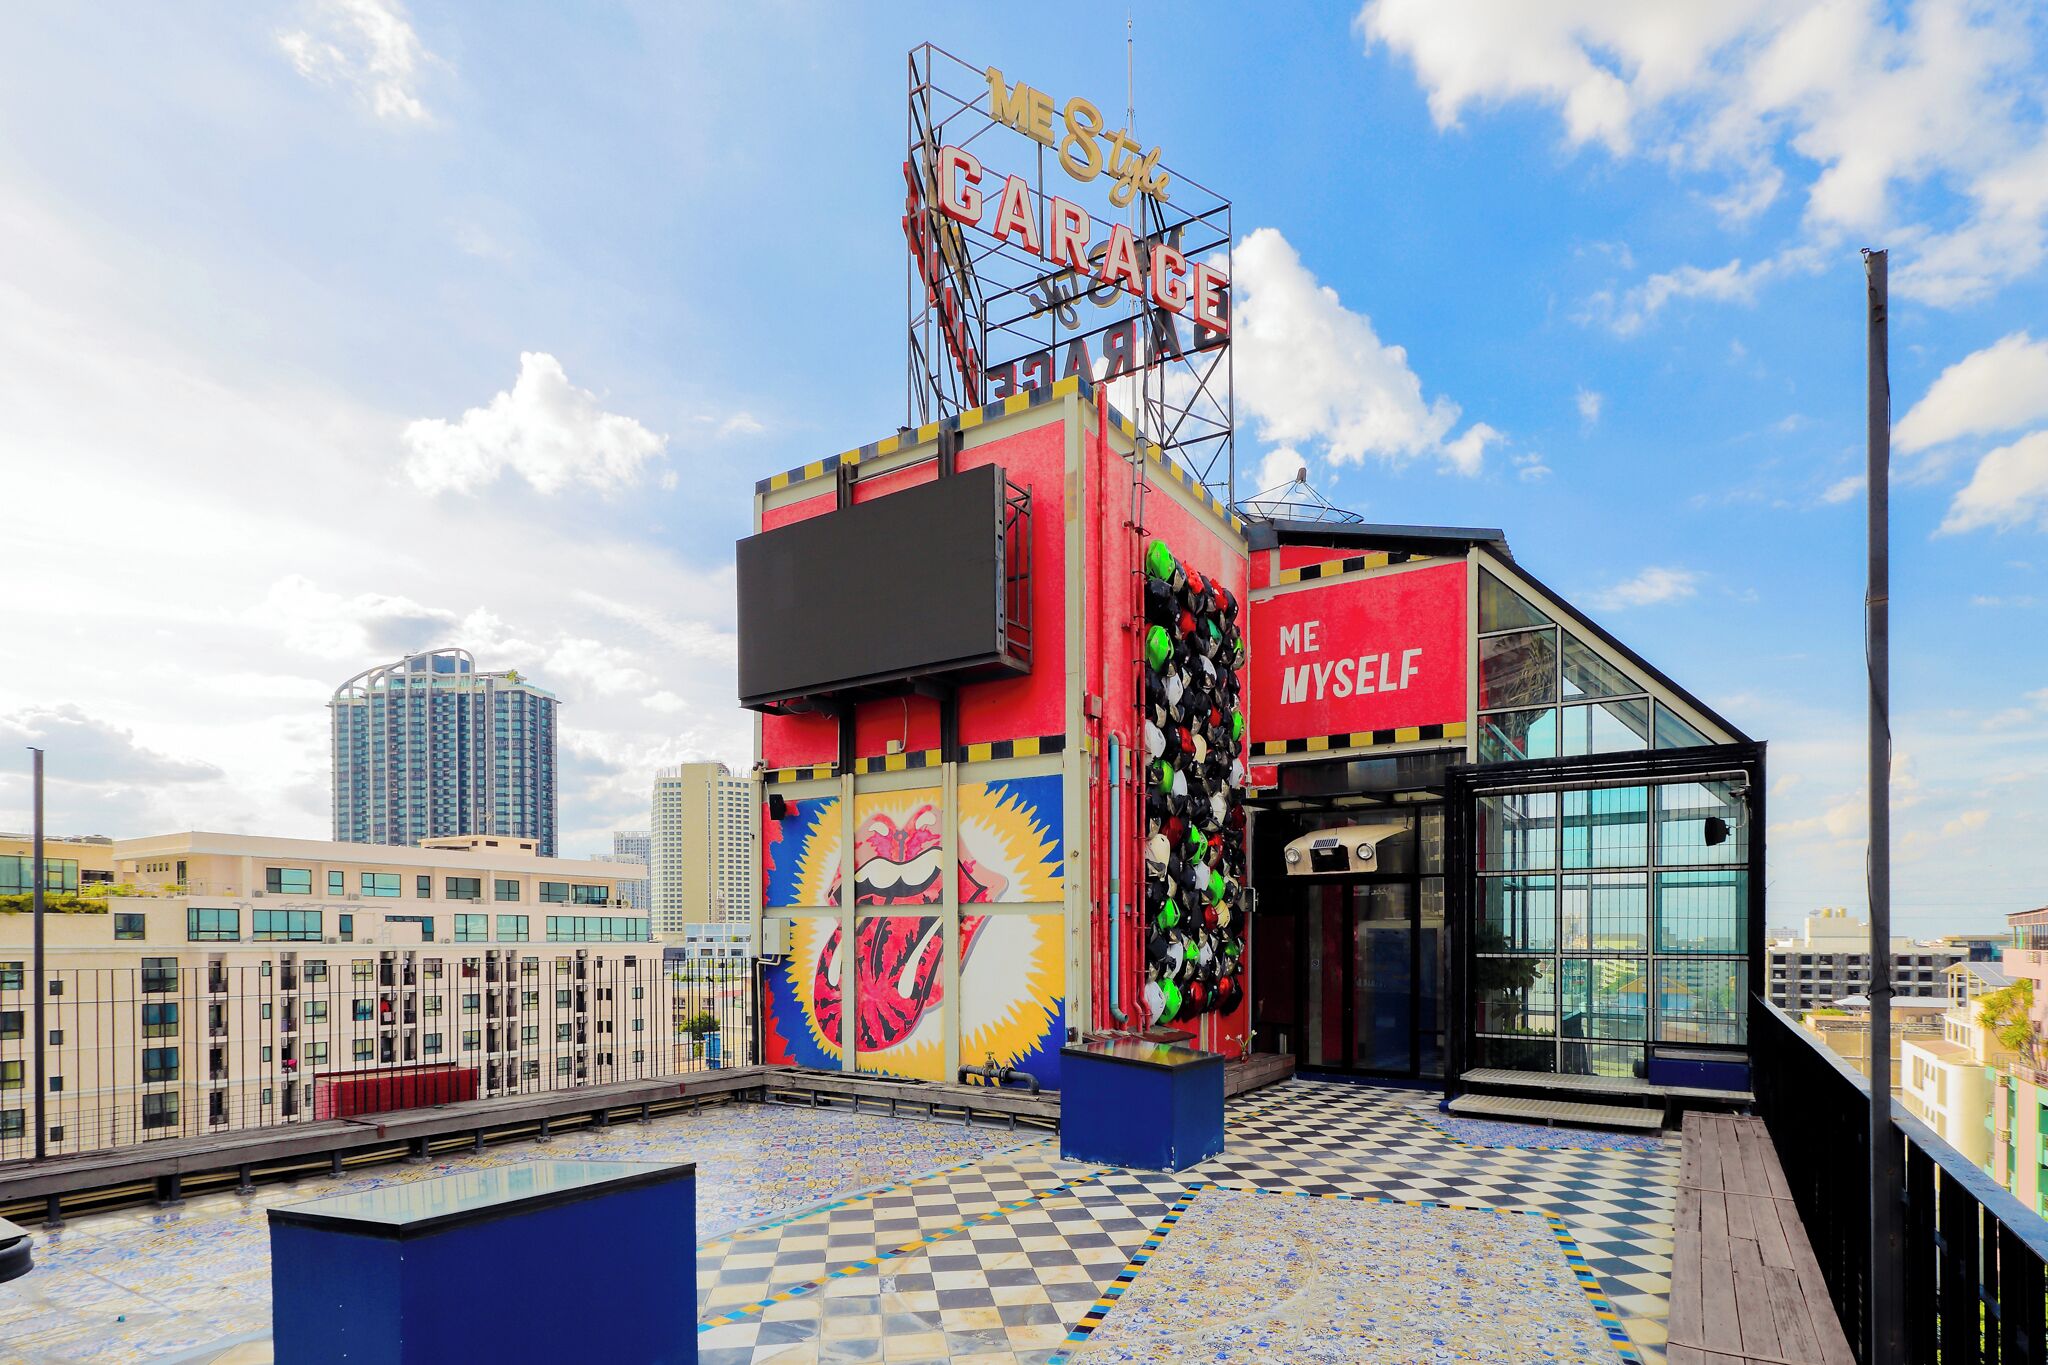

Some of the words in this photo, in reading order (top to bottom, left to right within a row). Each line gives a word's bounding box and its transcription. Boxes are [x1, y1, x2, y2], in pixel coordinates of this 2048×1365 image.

[985, 66, 1055, 147] ME
[1058, 97, 1170, 208] Style
[938, 145, 1229, 334] GARAGE
[1280, 620, 1320, 656] ME
[1280, 648, 1423, 704] MYSELF
